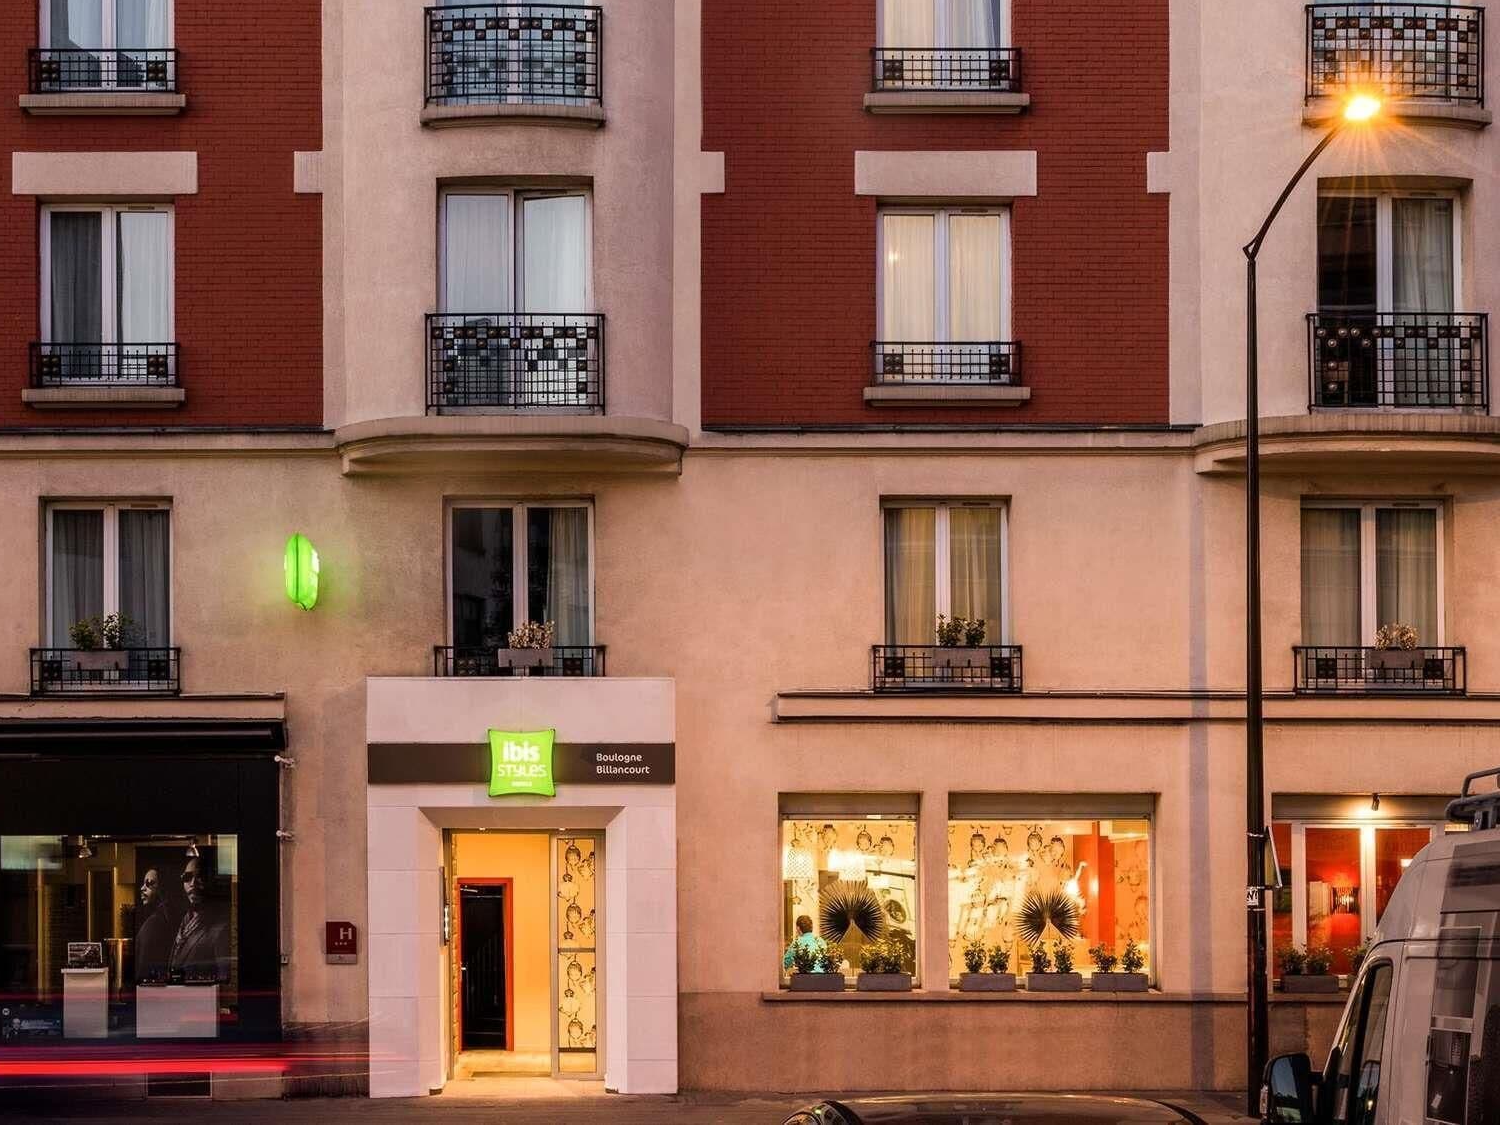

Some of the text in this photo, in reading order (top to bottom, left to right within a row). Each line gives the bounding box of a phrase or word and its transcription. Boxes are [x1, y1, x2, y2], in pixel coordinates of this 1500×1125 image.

[502, 740, 541, 763] ibis
[596, 753, 643, 764] Boulogne
[596, 765, 651, 775] Billancourt
[339, 927, 353, 940] H
